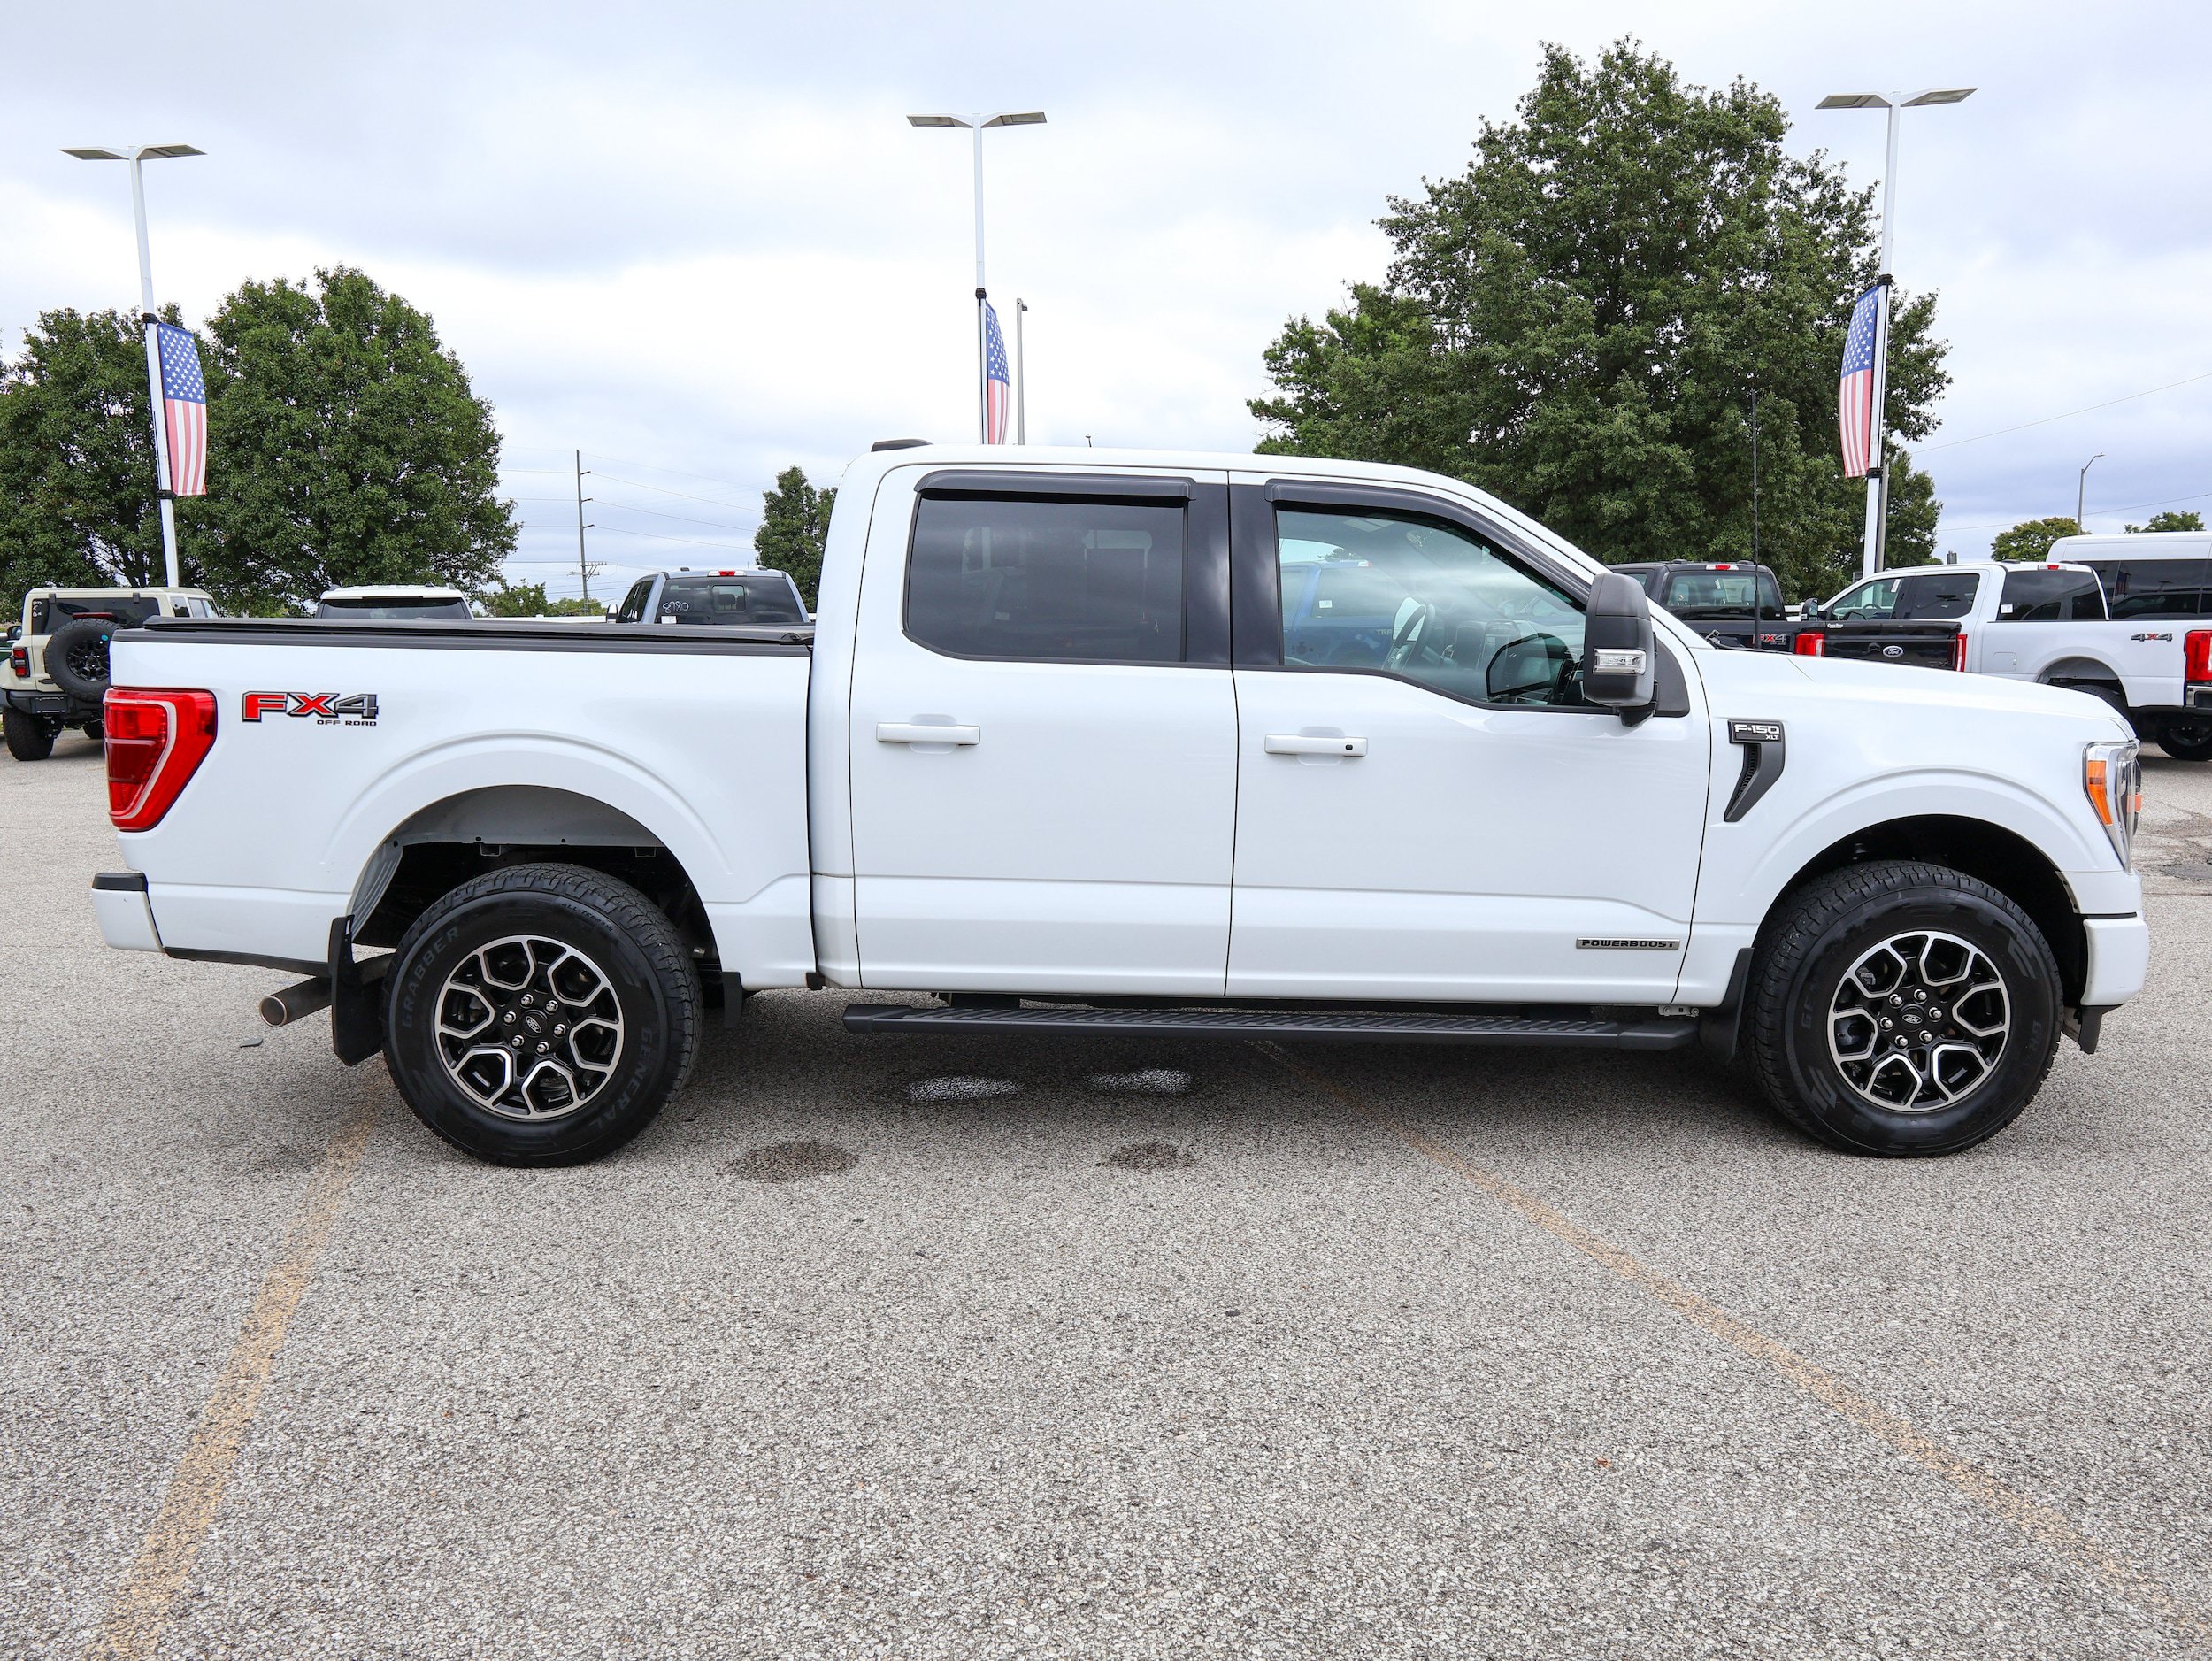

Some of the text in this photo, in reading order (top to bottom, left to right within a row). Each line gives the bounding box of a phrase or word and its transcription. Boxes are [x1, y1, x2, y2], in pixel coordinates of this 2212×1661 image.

[663, 601, 689, 613] 8980
[242, 691, 379, 722] FX4
[401, 926, 458, 1028] GRABBER
[588, 1027, 653, 1129] GENERAL
